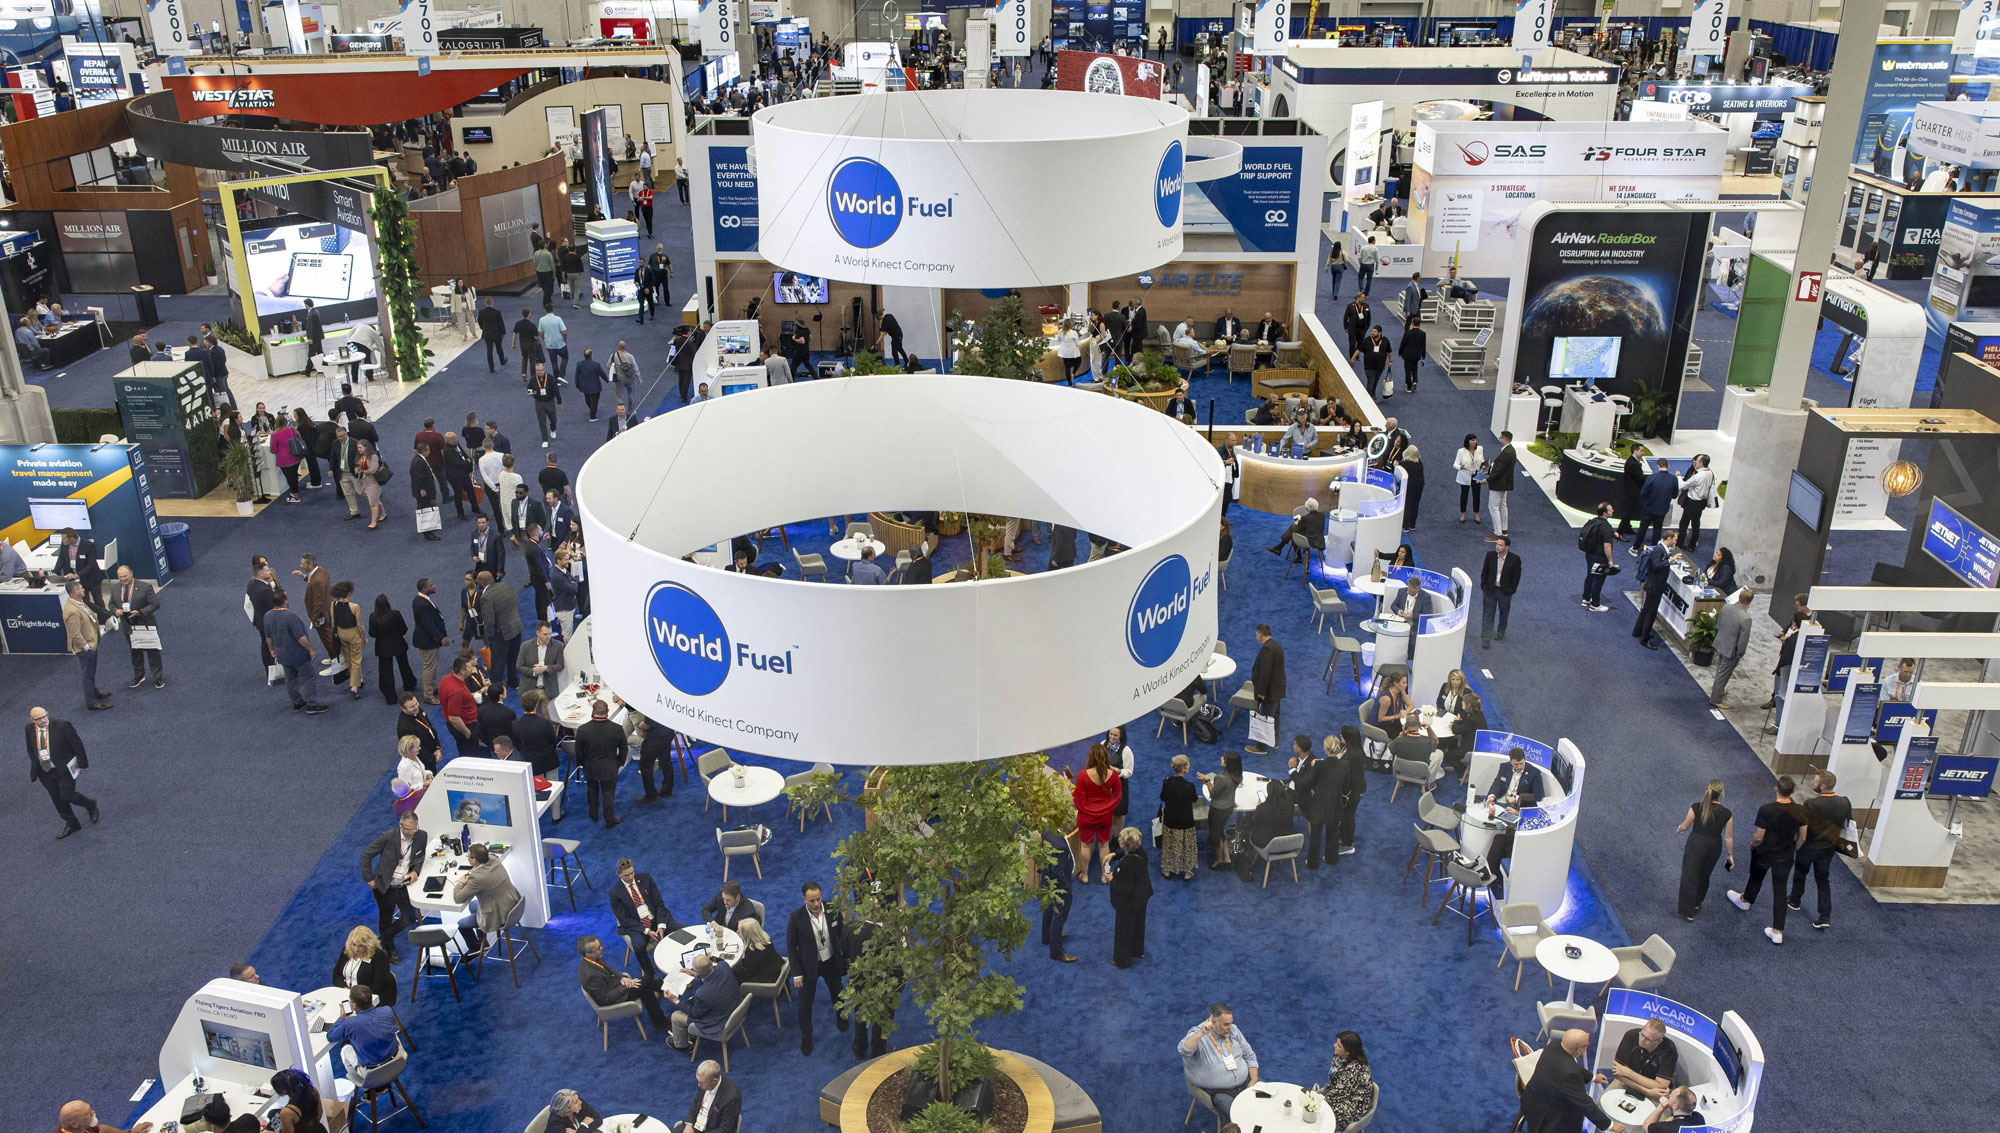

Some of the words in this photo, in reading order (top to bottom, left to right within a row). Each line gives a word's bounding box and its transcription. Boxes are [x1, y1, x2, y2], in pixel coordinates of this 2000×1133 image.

[1896, 61, 1949, 70] webmanuals
[1517, 70, 1568, 82] Lufthansa
[1569, 70, 1608, 82] Technik
[192, 90, 232, 101] WEST
[238, 89, 274, 100] STAR
[1723, 100, 1747, 108] SEATING
[1749, 100, 1754, 108] &
[1755, 100, 1787, 108] INTERIORS
[1916, 119, 1952, 138] CHARTER
[1955, 130, 1973, 142] HUB
[221, 138, 277, 154] MILLION
[280, 142, 307, 156] AIR
[1494, 145, 1547, 158] SAS
[1615, 148, 1659, 157] FOUR
[1663, 148, 1706, 157] STAR
[1160, 170, 1182, 198] World
[333, 190, 355, 209] Smart
[834, 191, 896, 215] World
[337, 209, 362, 227] Aviation
[720, 215, 740, 228] GO
[1265, 210, 1287, 222] GO
[493, 218, 524, 233] MILLION
[1597, 233, 1657, 244] RadarBox
[834, 255, 840, 264] A
[843, 256, 869, 267] World
[871, 258, 901, 270] Kinect
[905, 260, 955, 273] Company
[1158, 273, 1189, 287] AIR
[1192, 273, 1243, 287] ELITE
[185, 406, 213, 430] 4AIR
[38, 470, 93, 479] management
[1931, 521, 1960, 545] JETNET
[1979, 536, 2000, 554] JETNET
[1427, 576, 1440, 584] Fuel
[1137, 586, 1188, 634] World
[18, 620, 60, 629] FlightBridge
[653, 616, 723, 662] World
[1133, 688, 1140, 700] A
[1142, 674, 1168, 694] World
[1169, 660, 1190, 680] Kinect
[1190, 634, 1211, 664] Company
[656, 694, 663, 705] A
[664, 696, 695, 718] World
[697, 709, 733, 730] Kinect
[736, 720, 799, 743] Company
[1526, 745, 1542, 755] Fuel
[1940, 769, 1989, 778] JETNET
[195, 999, 212, 1009] Flying
[212, 1003, 229, 1011] Tigers
[230, 1006, 253, 1015] Aviation
[1642, 1001, 1695, 1026] AVCARD
[1659, 1016, 1680, 1027] WORLD
[1681, 1024, 1694, 1034] FUEL
